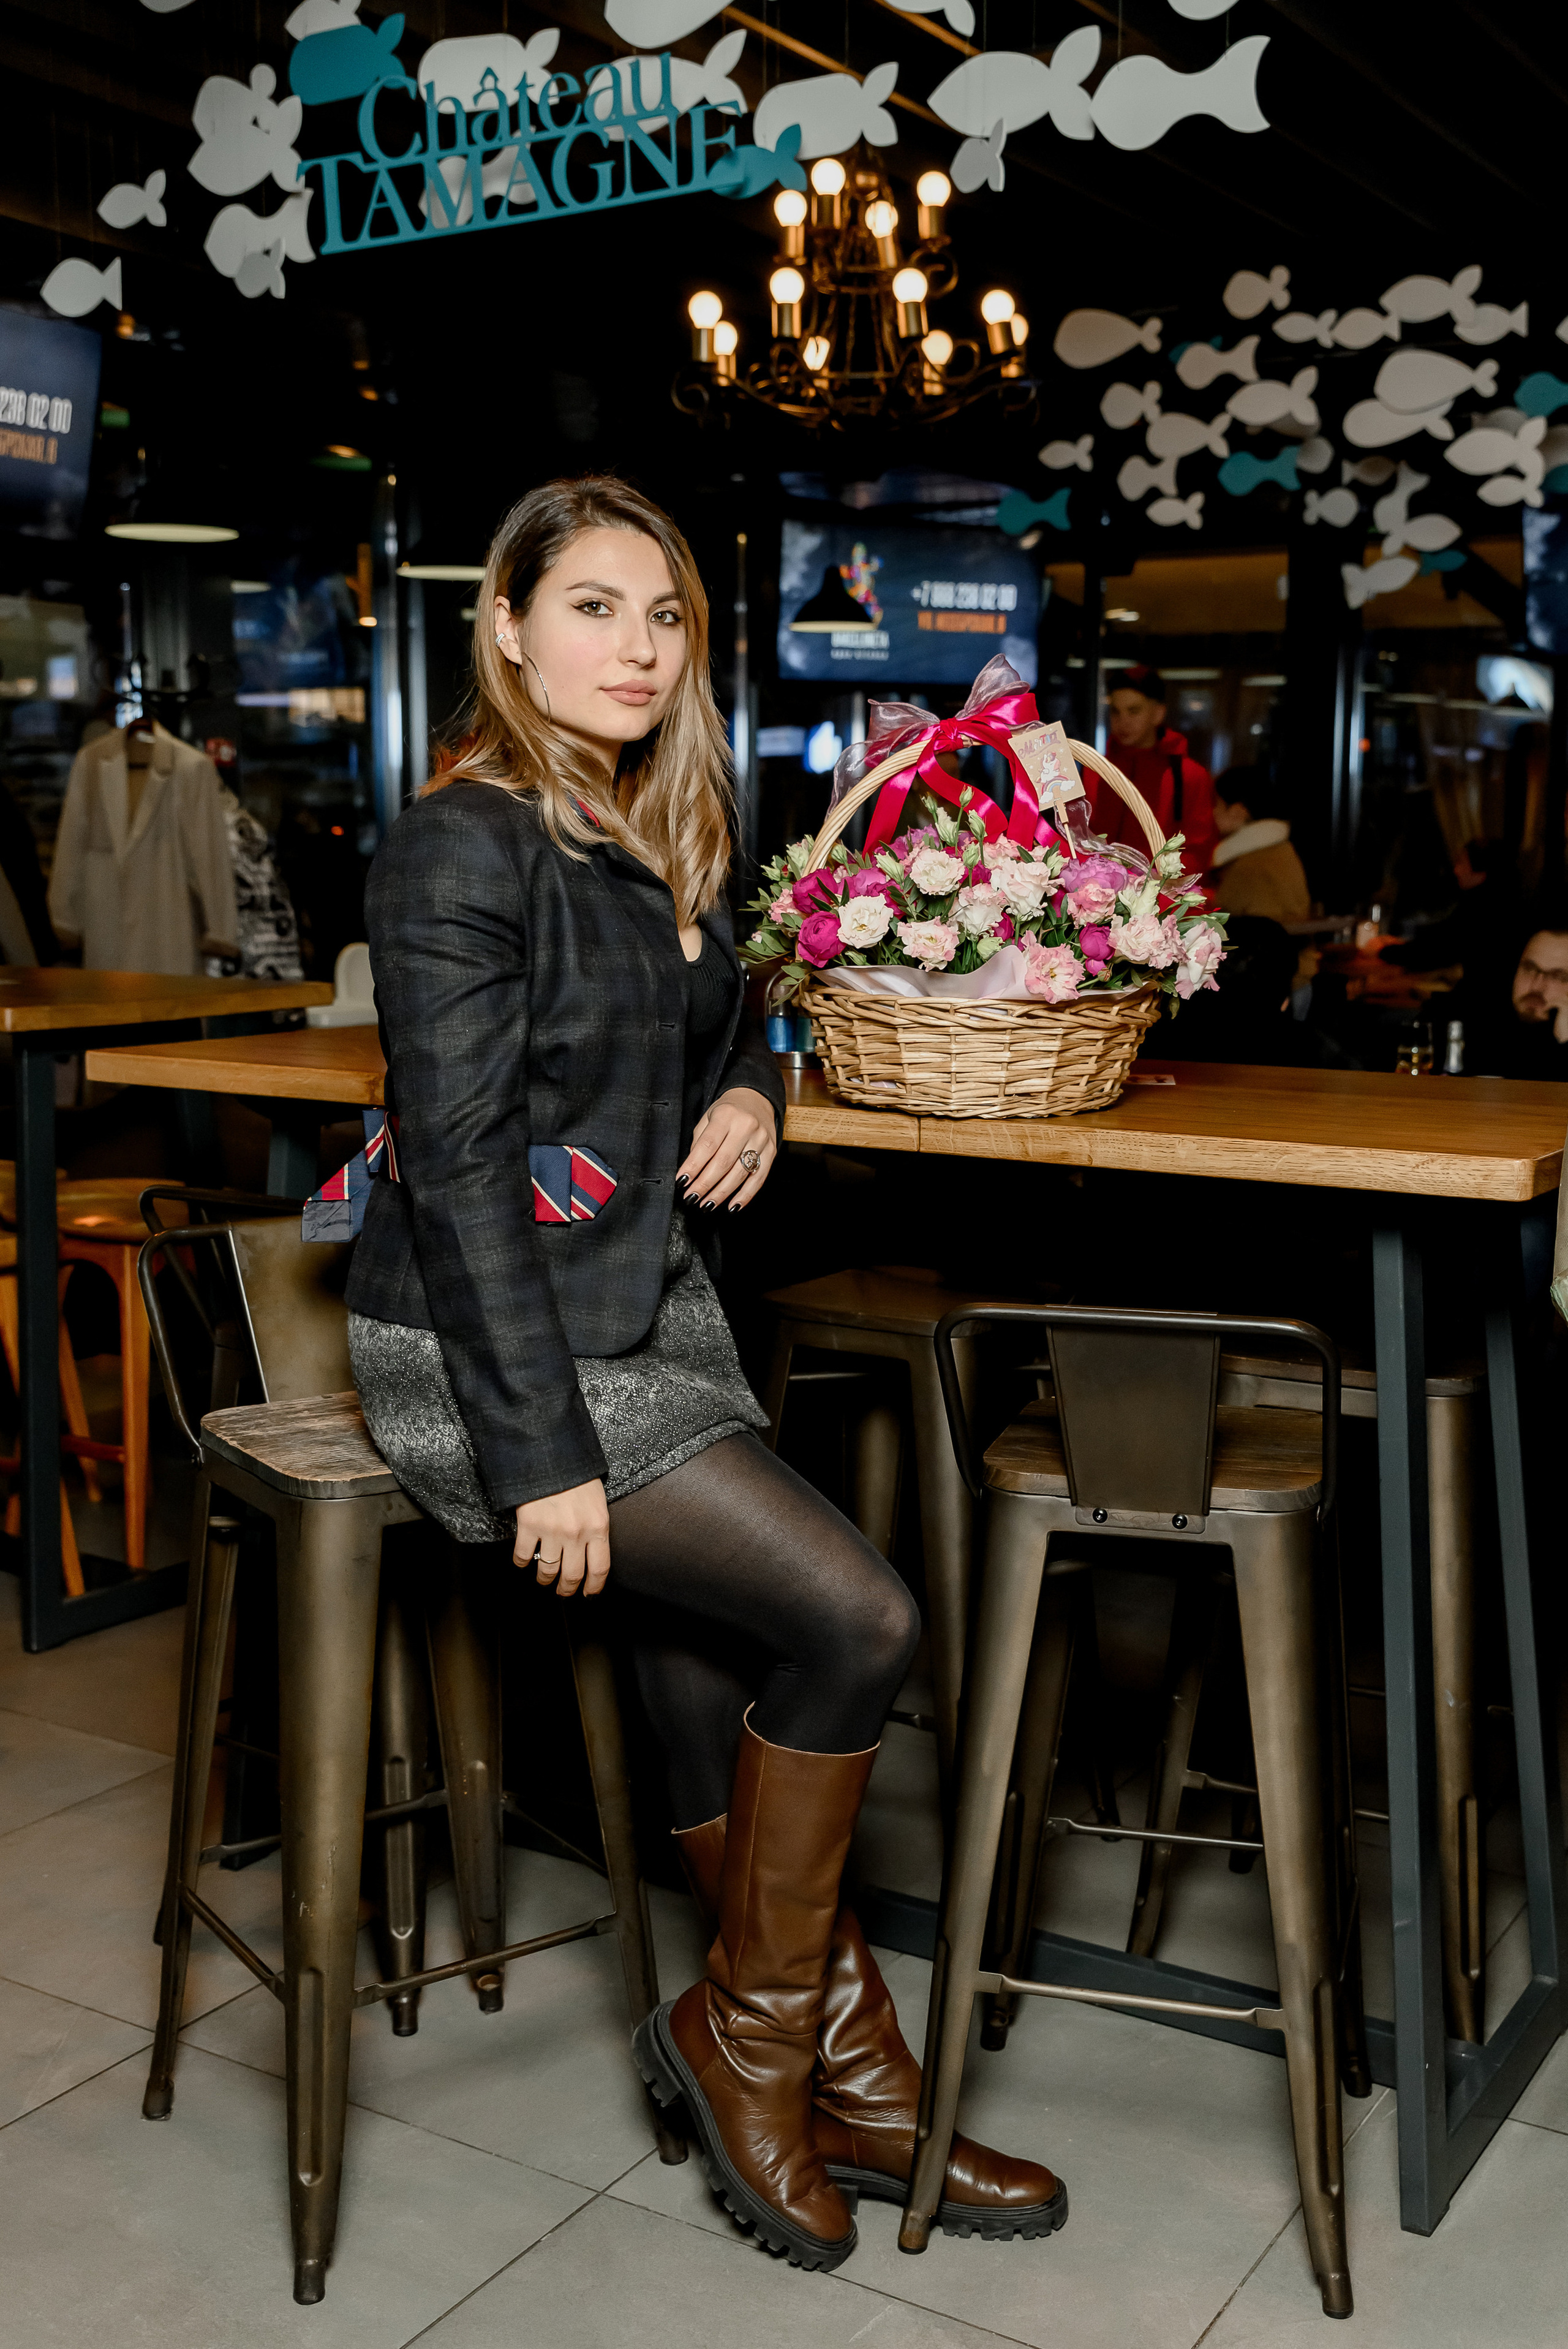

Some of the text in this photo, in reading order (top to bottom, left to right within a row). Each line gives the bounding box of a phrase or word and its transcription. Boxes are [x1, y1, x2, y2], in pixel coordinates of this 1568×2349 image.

[358, 51, 679, 163] Château
[296, 100, 744, 254] TAMAGNE
[26, 392, 50, 430] 02
[48, 396, 72, 434] 00
